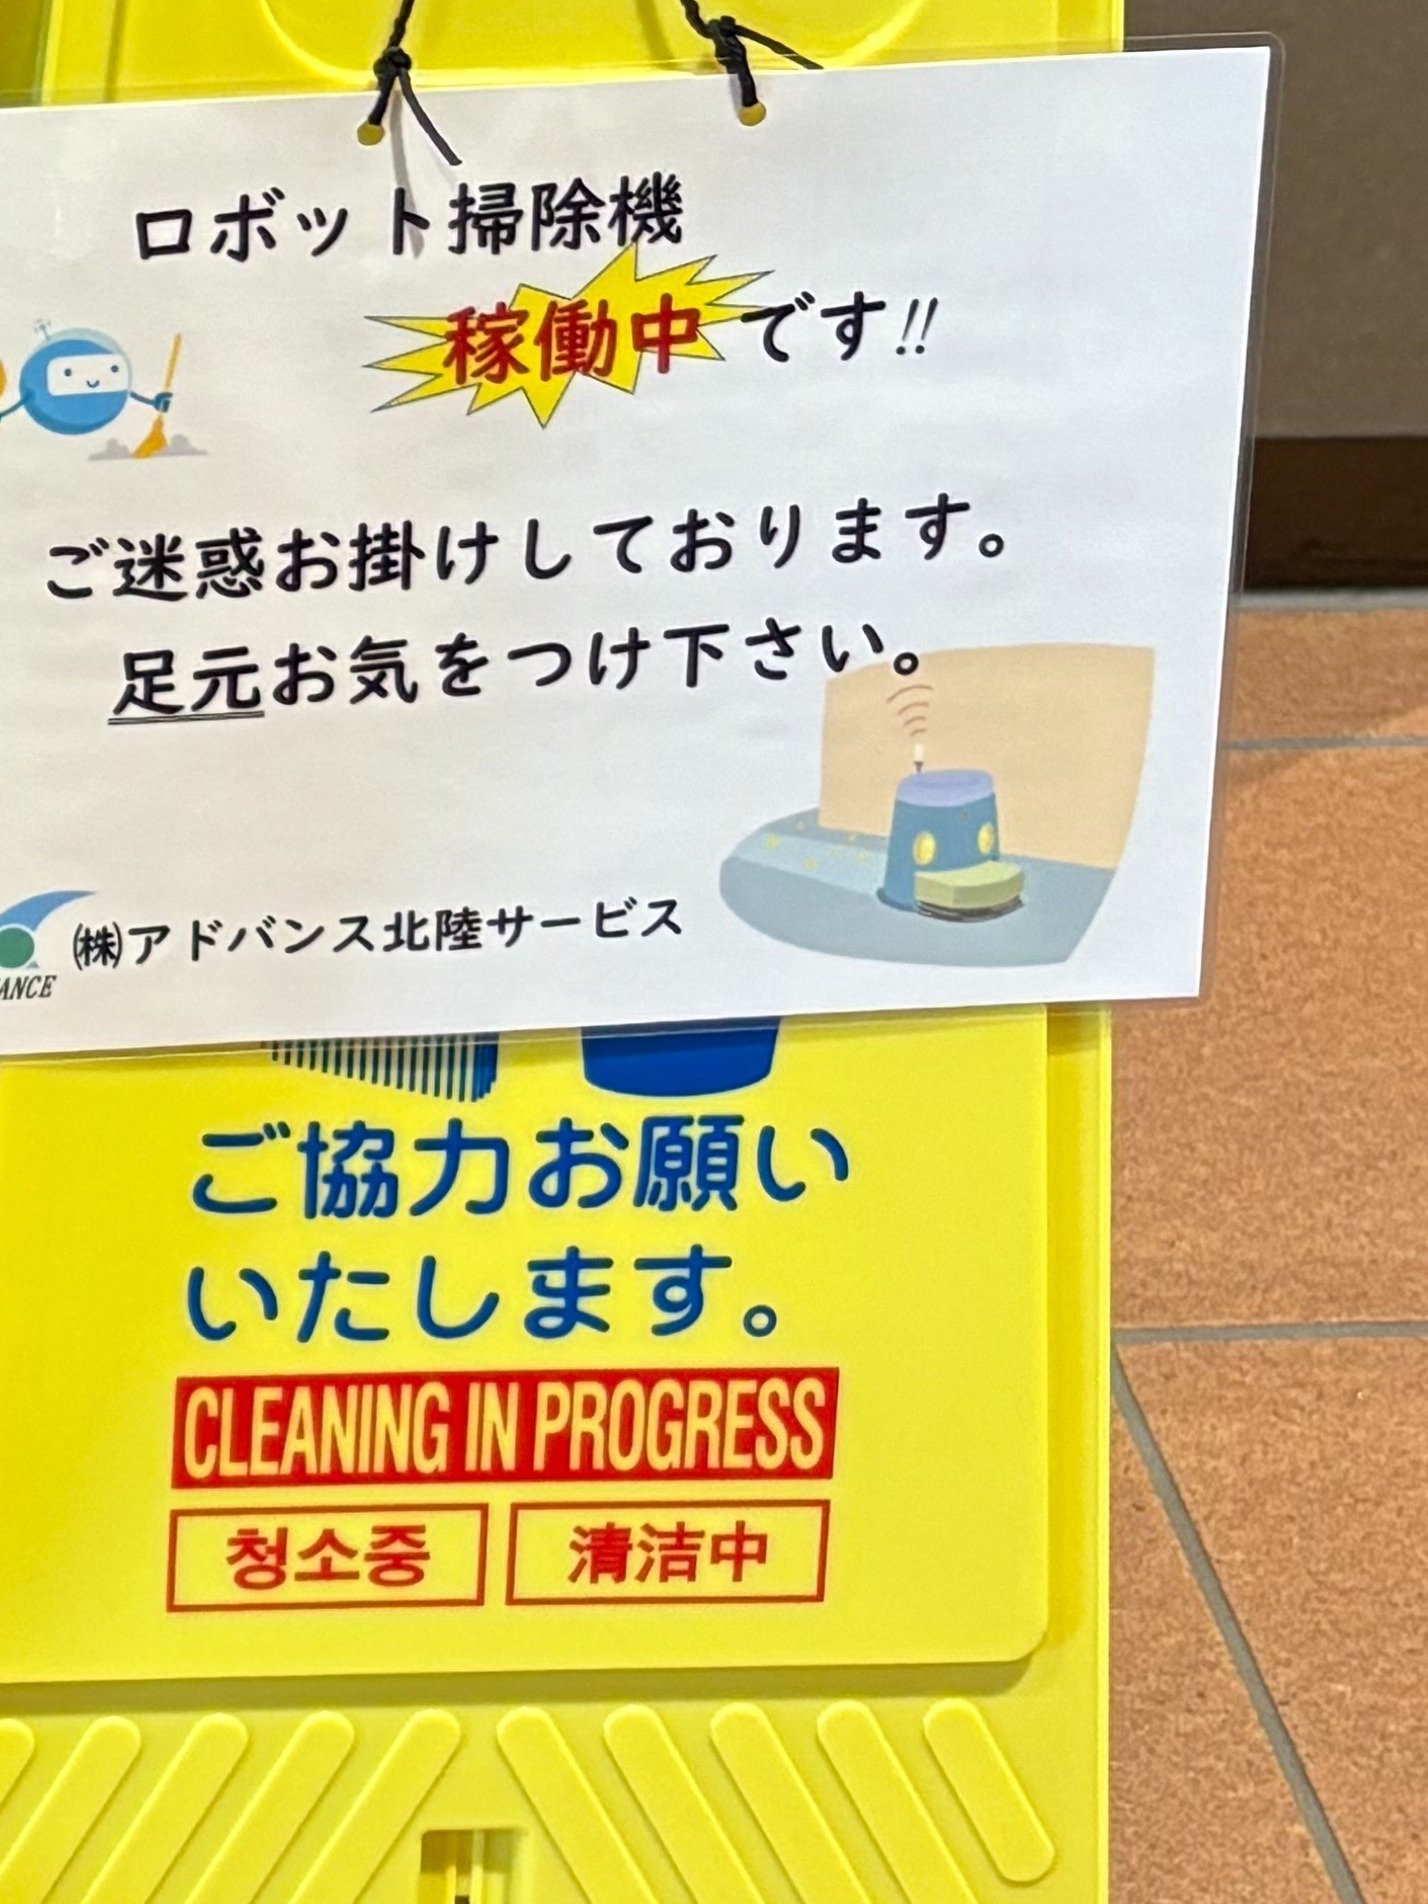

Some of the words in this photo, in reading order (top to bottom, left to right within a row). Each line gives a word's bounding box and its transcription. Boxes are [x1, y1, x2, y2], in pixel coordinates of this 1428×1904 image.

[133, 169, 685, 264] ロボット掃除機
[44, 491, 1008, 604] ご迷惑お掛けしております。
[107, 613, 924, 724] 足元お気をつけ下さい。
[191, 1114, 851, 1220] ご協力お願い
[185, 1245, 779, 1343] いたします。
[184, 1382, 448, 1479] CLEANING
[467, 1386, 517, 1471] IN
[532, 1379, 824, 1472] PROGRESS
[227, 1523, 432, 1590] 청소중
[568, 1520, 769, 1586] 清洁中
